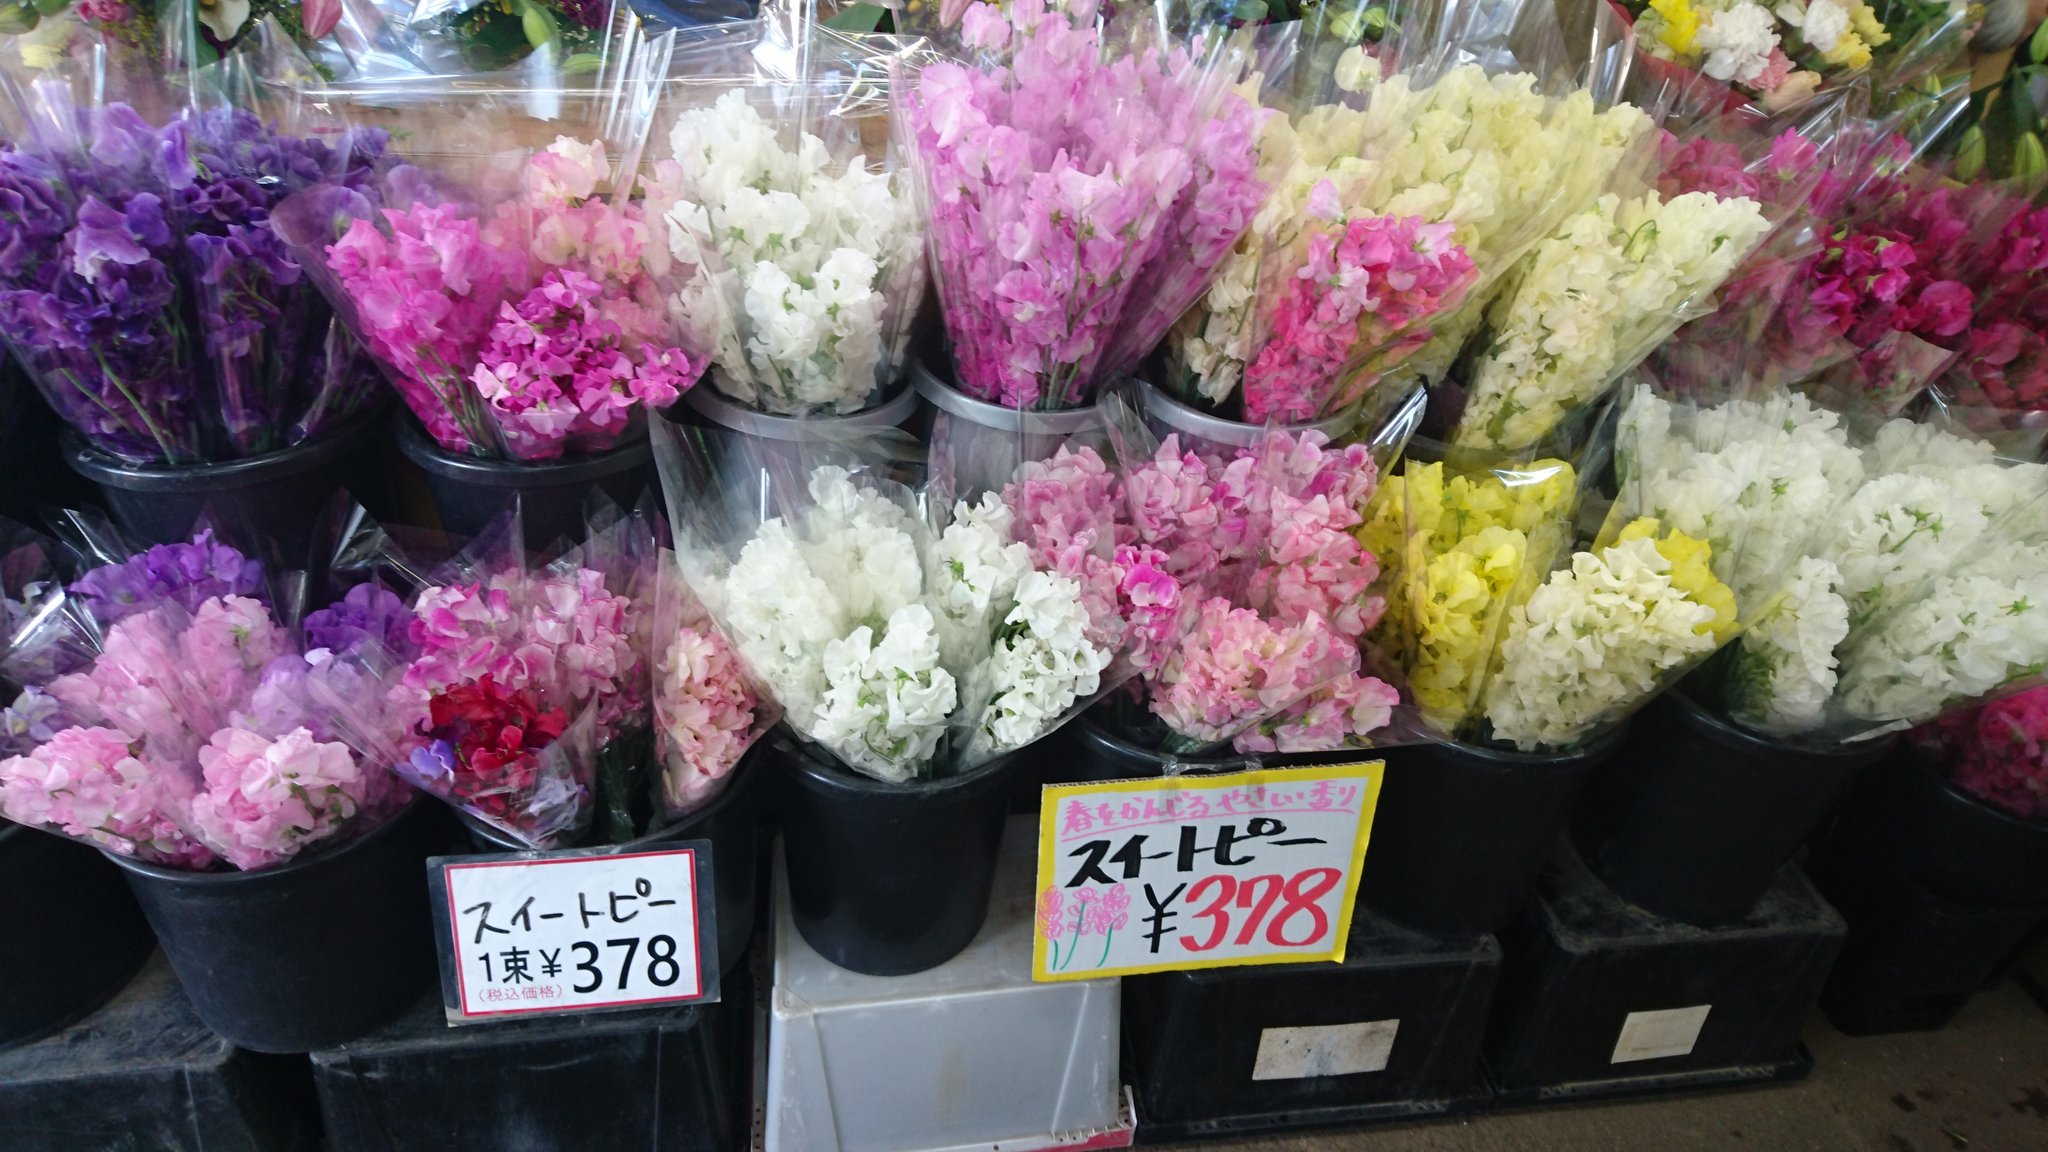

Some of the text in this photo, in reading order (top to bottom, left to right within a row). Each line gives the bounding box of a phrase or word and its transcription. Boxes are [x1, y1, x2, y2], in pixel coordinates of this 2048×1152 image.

[1065, 817, 1328, 888] スイートピー
[463, 877, 676, 944] スイートピー
[1141, 867, 1343, 953] ¥378
[478, 984, 565, 1003] (税込価格)
